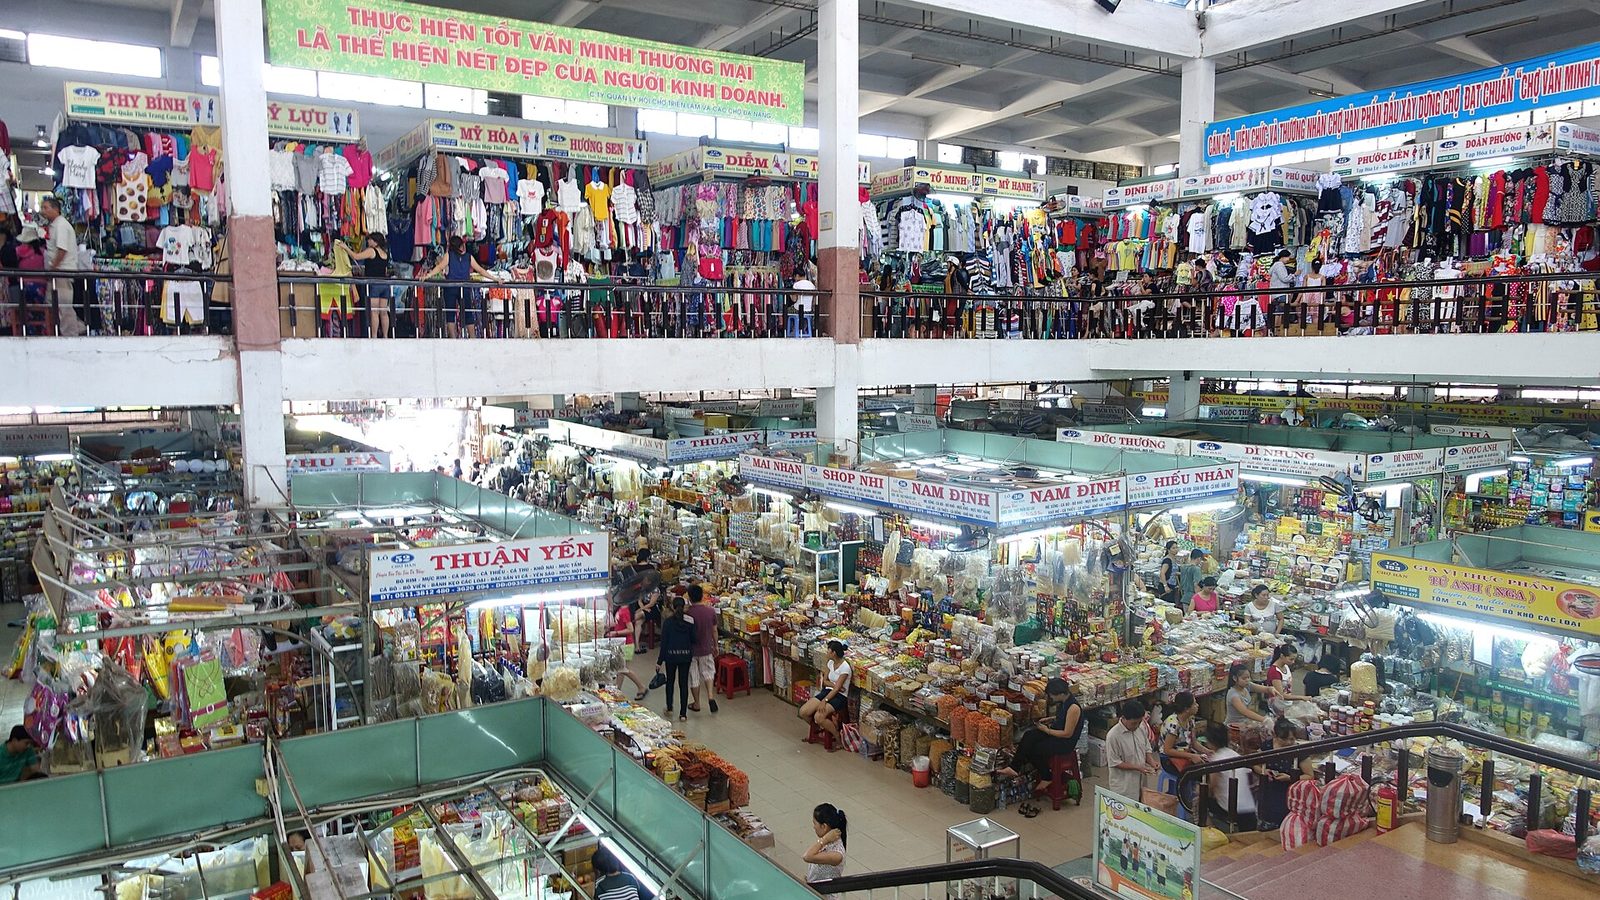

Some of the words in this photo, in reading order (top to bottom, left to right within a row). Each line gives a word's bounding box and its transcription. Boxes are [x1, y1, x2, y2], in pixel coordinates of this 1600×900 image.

[347, 6, 412, 34] THỰC
[420, 17, 475, 44] HIỆN
[482, 20, 522, 48] TỐT
[529, 31, 572, 56] VĂN
[579, 40, 632, 64] MINH
[638, 49, 714, 76] THƯƠNG
[719, 60, 753, 83] MẠI
[337, 28, 384, 57] THỂ
[392, 41, 449, 66] HIỆN
[456, 48, 498, 72] NÉT
[505, 57, 548, 79] ĐẸP
[555, 60, 597, 84] CỦA
[604, 69, 664, 93] NGƯỜI
[671, 78, 715, 99] KINH
[721, 87, 787, 109] DOANH.
[105, 92, 141, 110] THY
[1208, 130, 1221, 157] CÁN
[1221, 128, 1231, 159] BỘ
[1235, 125, 1250, 151] VIÊN
[1250, 121, 1268, 149] CHỨC
[1268, 118, 1278, 146] VÀ
[1279, 117, 1306, 144] THƯƠNG
[1307, 110, 1327, 140] NHÂN
[1328, 109, 1342, 140] CHỢ
[1343, 105, 1359, 131] HÀN
[1361, 97, 1382, 128] PHẤN
[1382, 93, 1399, 125] ĐẤU
[1400, 93, 1417, 122] XÂY
[1418, 91, 1441, 124] DỰNG
[1443, 86, 1461, 118] CHỢ
[1464, 84, 1481, 116] ĐẠT
[1483, 69, 1514, 107] CHUẨN
[1542, 63, 1562, 94] VĂN
[1564, 61, 1591, 92] MINH
[287, 108, 328, 127] LỰU
[459, 125, 483, 141] MỸ
[487, 127, 520, 145] HÒA
[1465, 136, 1488, 149] ĐOÀN
[1489, 131, 1522, 146] PHƯƠNG
[570, 137, 603, 154] HƯƠNG
[605, 142, 624, 155] SEN
[725, 152, 769, 169] DIỄM
[1357, 152, 1387, 165] PHƯỚC
[1388, 149, 1410, 162] LIÊN
[930, 173, 942, 183] TỐ
[944, 175, 967, 185] MINH
[1203, 174, 1223, 185] PHÚ
[1225, 171, 1246, 183] QUÝ
[1124, 185, 1148, 197] ĐỊNH
[1149, 183, 1164, 194] 159
[533, 409, 555, 418] KIM
[1093, 434, 1117, 445] ĐỨC
[1118, 437, 1166, 449] THƯƠNG
[1461, 445, 1481, 456] NGỌC
[1482, 443, 1498, 453] ANH
[752, 457, 771, 470] MAI
[1263, 449, 1315, 460] NHUNG
[1402, 452, 1424, 462] NHUNG
[822, 468, 856, 484] SHOP
[859, 474, 884, 489] NHI
[1153, 470, 1190, 488] HIẾU
[1194, 467, 1235, 483] NHÂN
[911, 482, 945, 500] NAM
[949, 488, 991, 507] ĐỊNH
[1030, 486, 1071, 504] NAM
[1077, 479, 1121, 499] ĐỊNH
[395, 555, 411, 563] 52
[429, 545, 530, 571] THUẬN
[538, 537, 594, 561] YẾN
[1413, 564, 1439, 574] GIA
[1463, 571, 1503, 583] THỰC
[1508, 578, 1555, 592] PHẨM
[1450, 579, 1483, 594] ANH
[1493, 586, 1526, 601] NGA
[1431, 595, 1449, 604] TÔM
[1475, 604, 1495, 613] MỰC
[1517, 610, 1534, 619] KHÔ
[1538, 614, 1556, 623] CÁC
[1559, 618, 1581, 628] LOẠI
